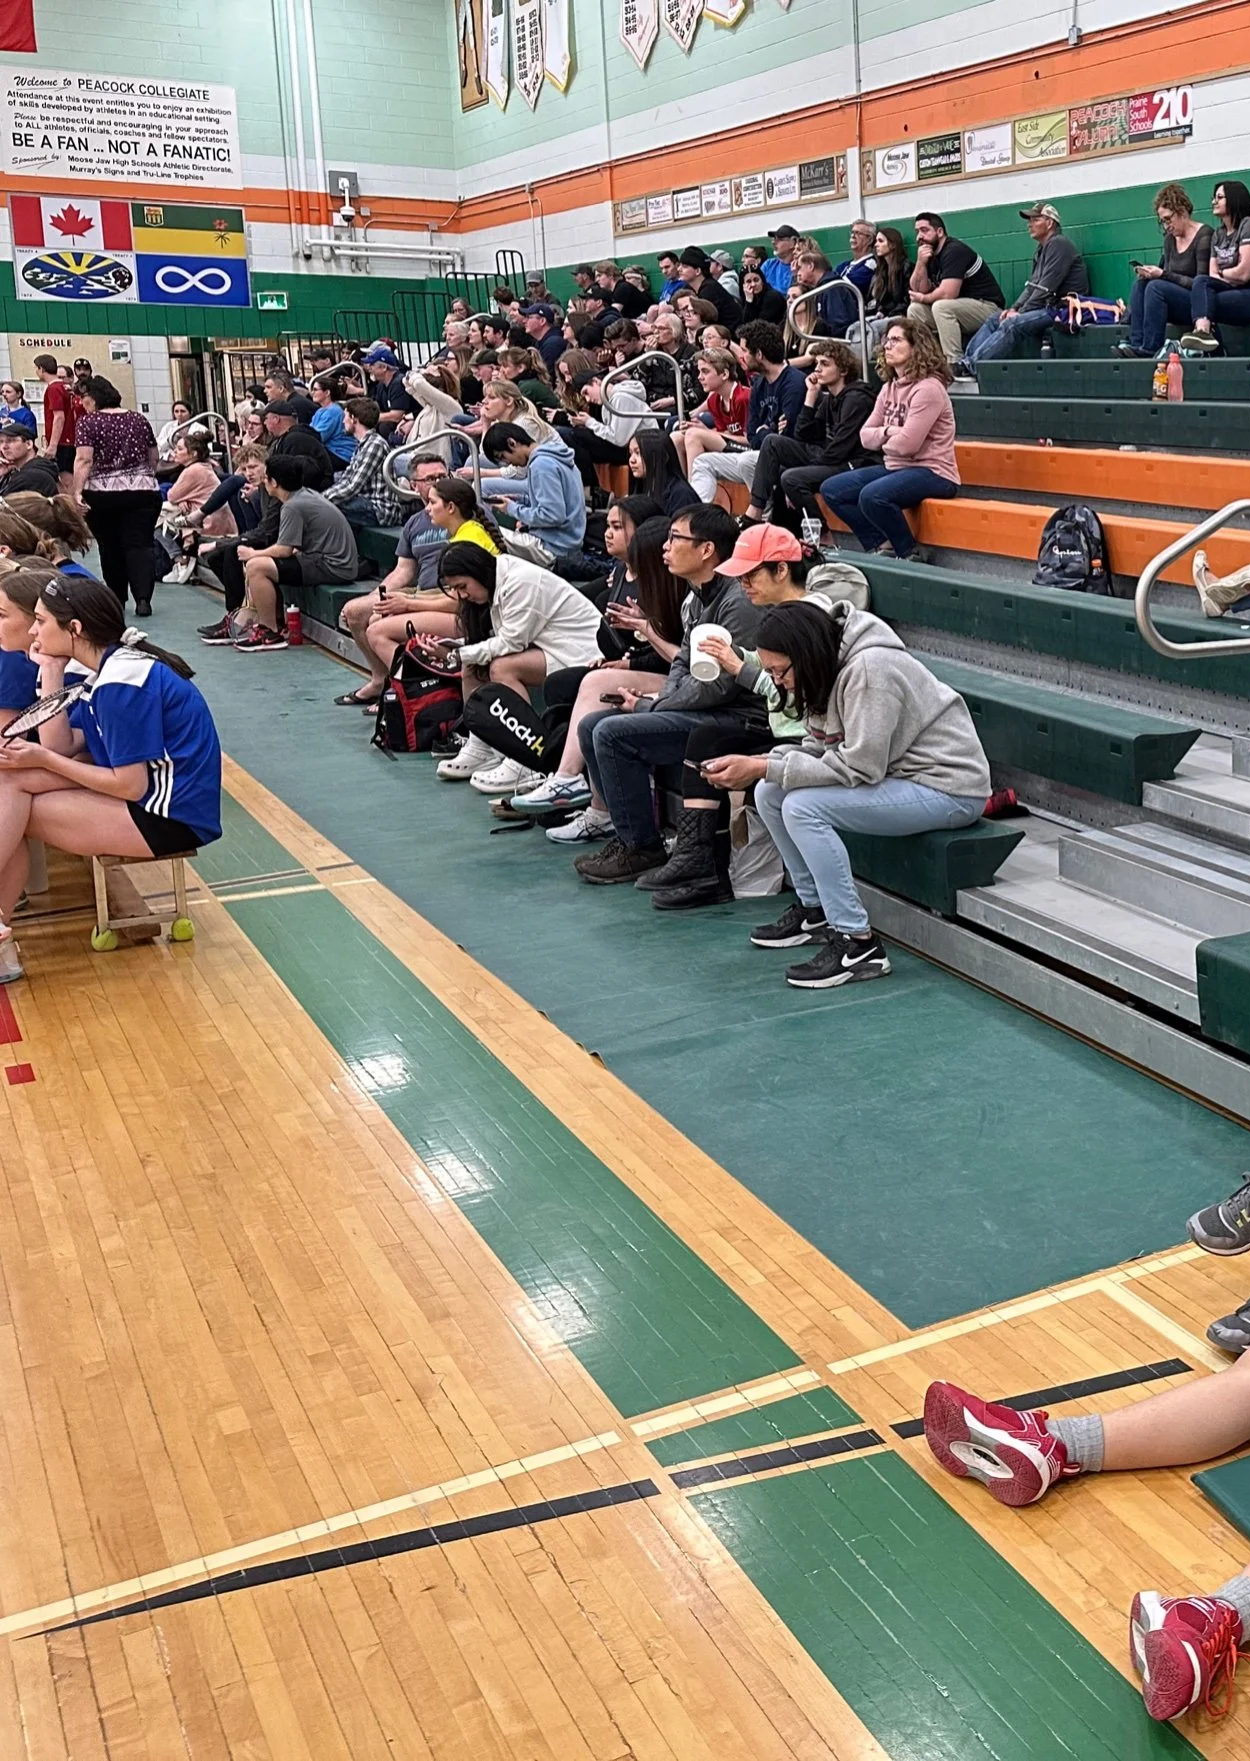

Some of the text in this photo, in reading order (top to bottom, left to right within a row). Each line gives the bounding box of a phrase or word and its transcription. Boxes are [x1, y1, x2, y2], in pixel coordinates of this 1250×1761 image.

[13, 76, 210, 101] Welcome to PEACOCK COLLEGIATE
[6, 90, 53, 101] Attendance
[65, 95, 80, 103] this
[105, 99, 135, 108] entitles
[136, 102, 151, 110] you
[152, 102, 161, 110] to
[162, 104, 183, 113] enjoy
[196, 106, 232, 116] exhibition
[7, 99, 16, 107] of
[19, 100, 40, 108] skills
[41, 102, 82, 112] developed
[84, 105, 94, 114] by
[95, 106, 127, 116] athletes
[128, 108, 136, 116] in
[148, 111, 193, 121] educational
[194, 115, 220, 124] setting
[1129, 96, 1148, 108] Prairie
[1152, 84, 1193, 130] 210
[14, 112, 37, 121] Please
[40, 114, 51, 122] be
[52, 116, 95, 126] respectful
[113, 121, 163, 132] encouraging
[165, 123, 173, 131] in
[194, 127, 229, 136] approach
[1129, 109, 1148, 120] South
[25, 122, 41, 130] ALL
[113, 129, 146, 138] coaches
[148, 131, 162, 139] and
[164, 132, 186, 141] fellow
[1129, 120, 1153, 132] Schools
[12, 132, 35, 148] BE
[40, 134, 53, 149] A
[57, 136, 89, 152] FAN
[107, 139, 140, 155] NOT
[146, 142, 158, 157] A
[163, 143, 231, 162] FANATIC!
[11, 154, 48, 165] Sponsored
[67, 155, 94, 164] Moose
[112, 158, 130, 168] High
[131, 159, 161, 168] Schools
[162, 161, 191, 170] Athletic
[69, 165, 102, 175] Murray's
[104, 167, 125, 176] Signs
[173, 172, 204, 181] Trophies
[19, 338, 72, 347] SCHEDULE
